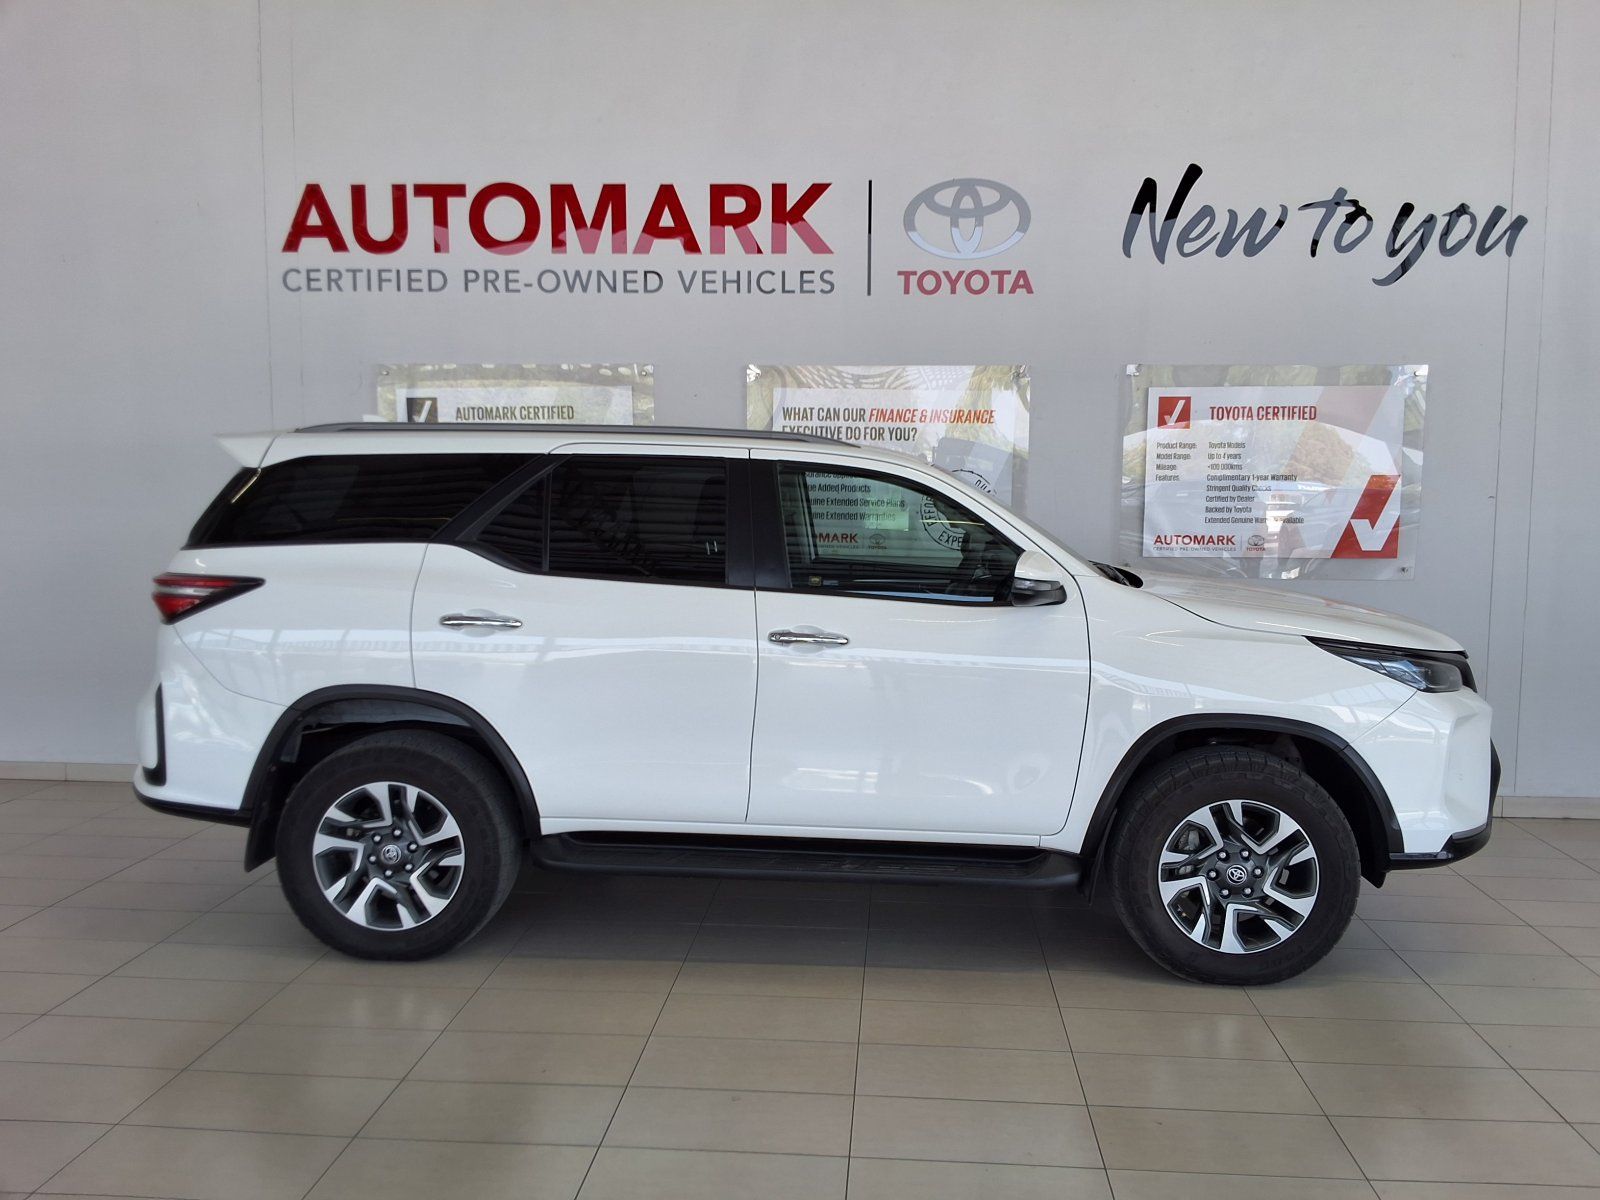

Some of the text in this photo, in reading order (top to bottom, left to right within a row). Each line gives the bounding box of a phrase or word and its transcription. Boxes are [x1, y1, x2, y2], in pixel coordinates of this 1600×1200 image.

[281, 181, 835, 255] AUTOMARK
[1121, 163, 1528, 287] New to you
[281, 268, 836, 295] CERTIFIED PRE-OWNED VEHICLES
[897, 269, 1034, 295] TOYOTA
[455, 405, 575, 421] AUTOMARK CERTIFIED
[782, 407, 996, 424] WHAT CAN OUR FINANCE & INSURANCE
[1209, 406, 1317, 421] TOYOTA CERTIFIED
[845, 427, 861, 441] DO
[863, 427, 885, 441] FOR
[887, 427, 918, 442] YOU?
[826, 498, 858, 507] Extended
[826, 512, 858, 520] Extended
[1154, 534, 1236, 546] AUTOMARK
